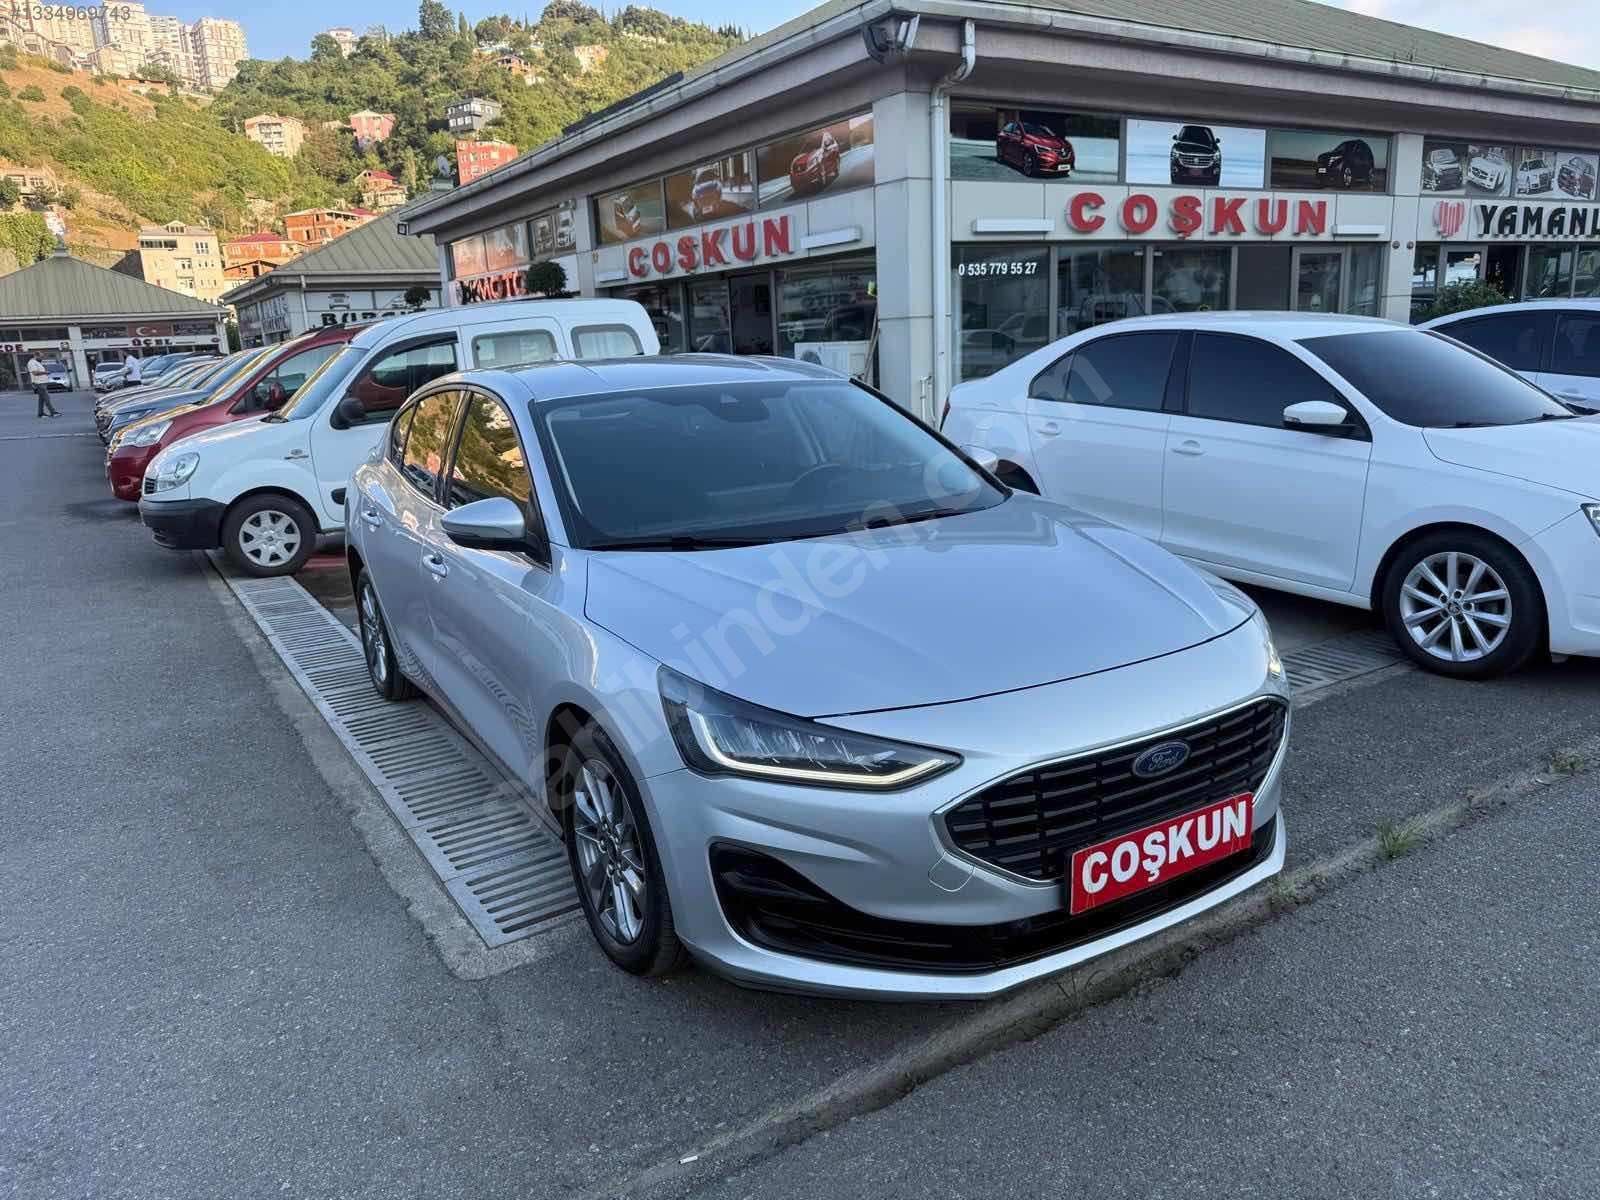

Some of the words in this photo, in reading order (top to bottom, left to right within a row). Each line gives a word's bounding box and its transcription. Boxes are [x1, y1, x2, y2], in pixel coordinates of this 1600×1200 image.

[1070, 192, 1327, 237] COŞKUN
[959, 264, 965, 276] 0
[968, 264, 987, 276] 535
[989, 263, 1008, 275] 779
[1010, 262, 1023, 274] 55
[1025, 262, 1037, 274] 27
[1149, 749, 1183, 771] Ford
[1082, 801, 1246, 893] COŞKUN
